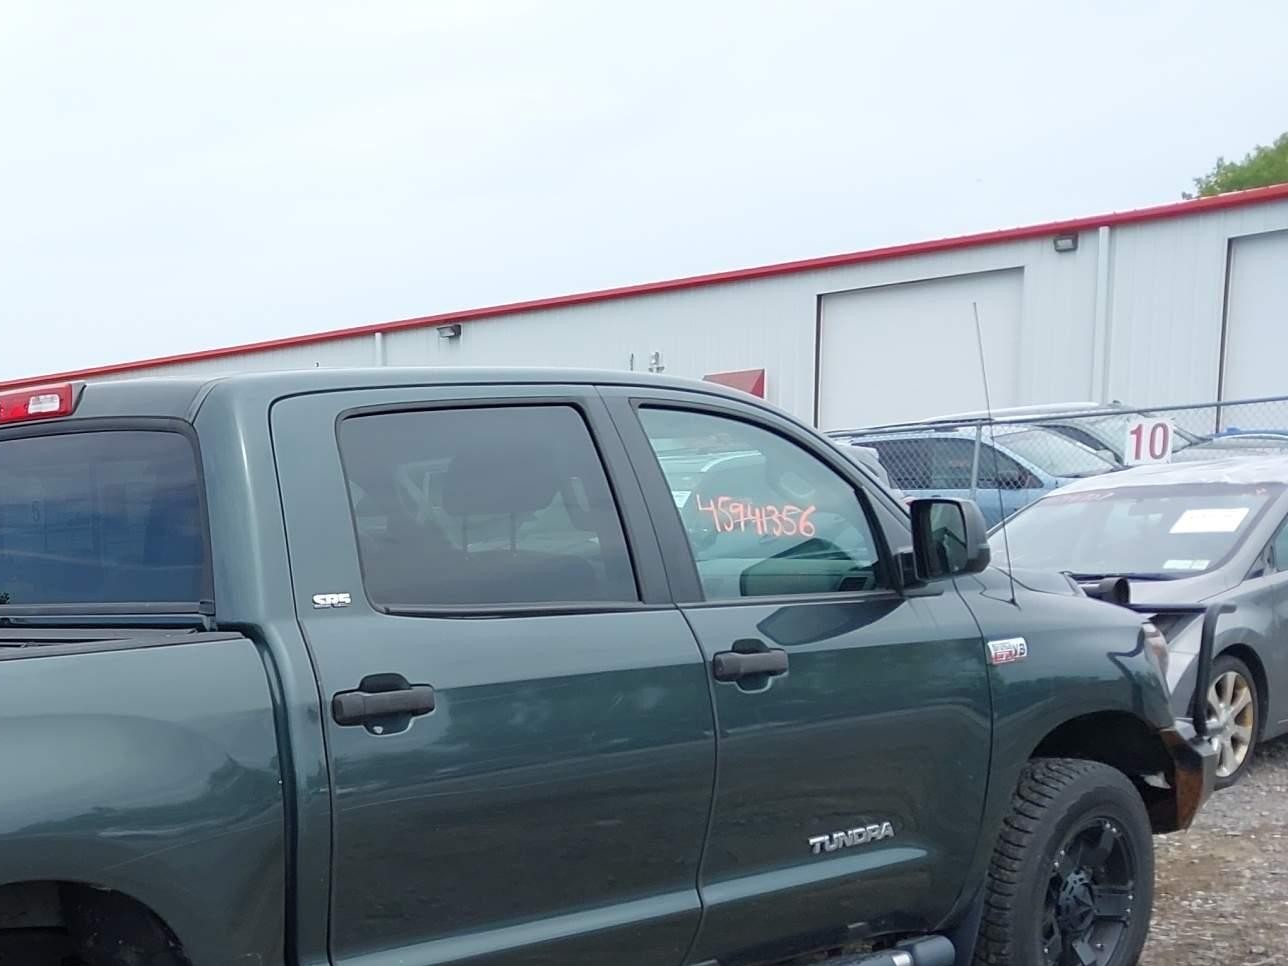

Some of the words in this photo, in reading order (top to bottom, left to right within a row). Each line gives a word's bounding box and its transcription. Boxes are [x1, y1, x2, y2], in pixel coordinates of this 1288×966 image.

[1129, 422, 1170, 461] 10
[696, 494, 817, 537] 45941356
[808, 821, 896, 854] TUNDRA
